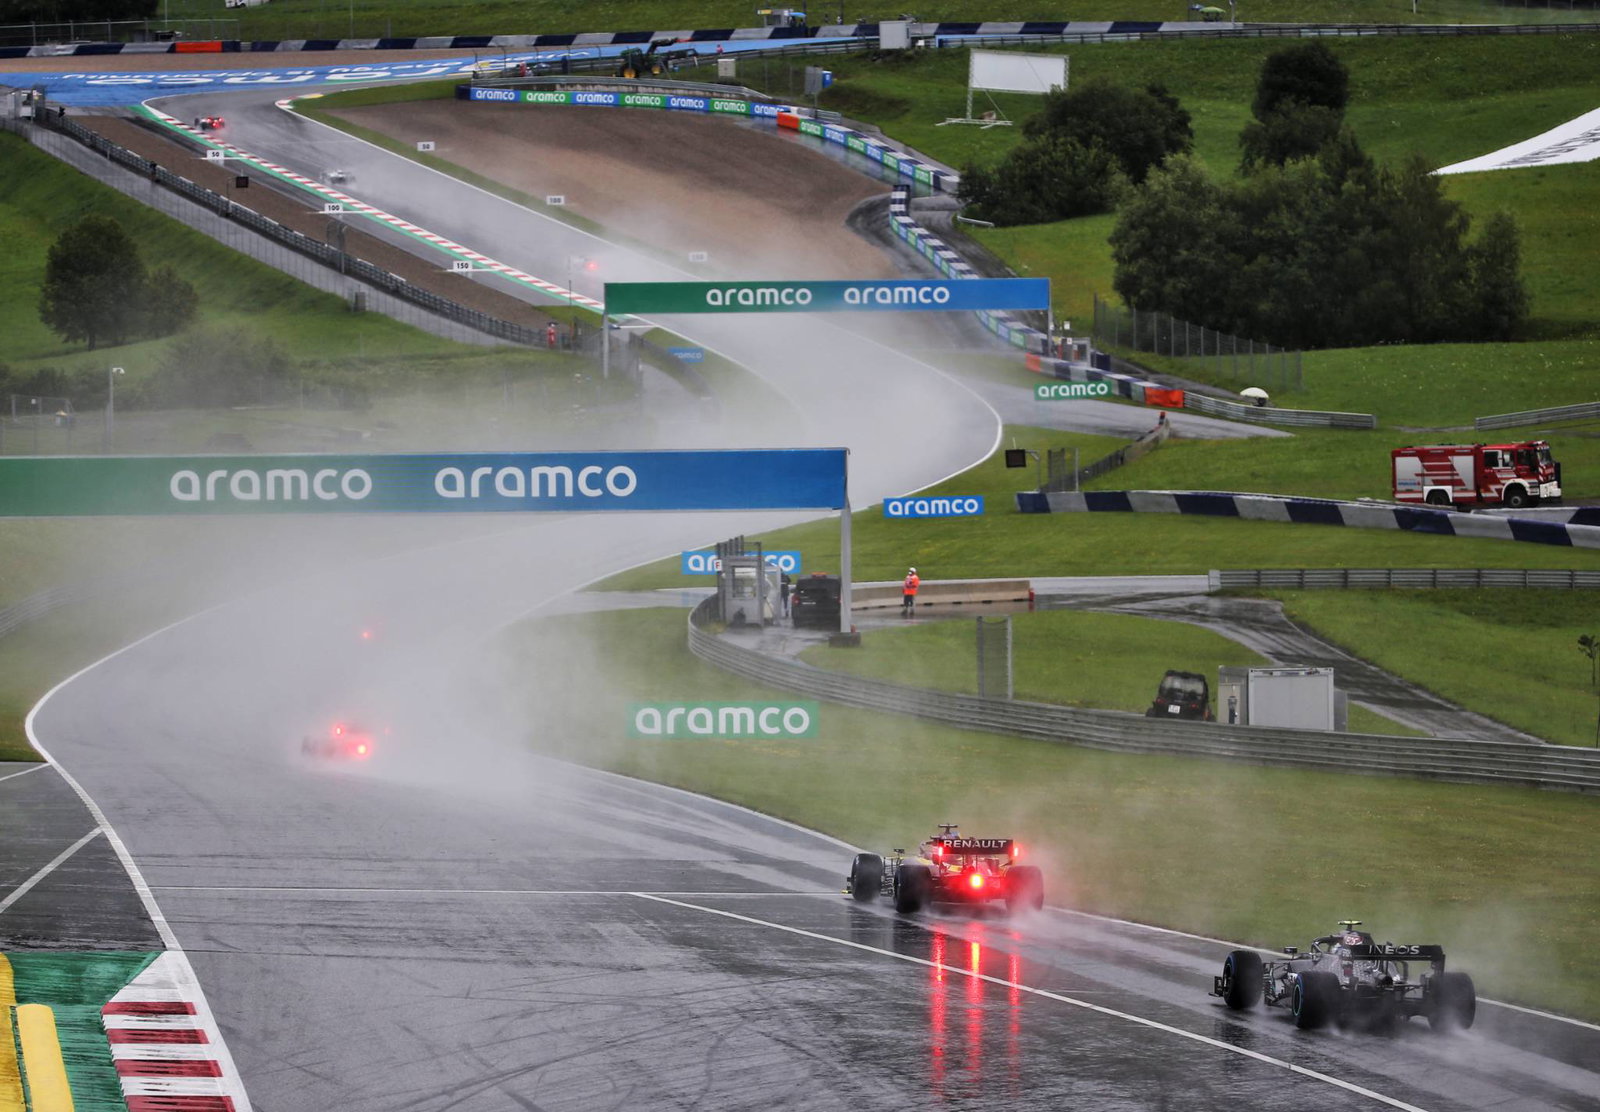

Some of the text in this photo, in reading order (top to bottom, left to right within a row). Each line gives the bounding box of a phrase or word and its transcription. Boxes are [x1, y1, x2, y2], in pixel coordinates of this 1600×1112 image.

[476, 90, 515, 100] aramco
[526, 91, 565, 102] aramco
[576, 92, 614, 103] aramco
[625, 94, 660, 106] aramco
[670, 97, 704, 108] aramco
[713, 101, 746, 112] aramco
[706, 286, 950, 306] aramco aramco
[1038, 382, 1108, 397] aramco
[170, 466, 637, 500] aramco aramco
[888, 498, 979, 515] aramco
[688, 555, 796, 571] arco
[635, 707, 810, 734] aramco
[944, 840, 1006, 848] RENAULT
[1369, 945, 1420, 954] INEOS
